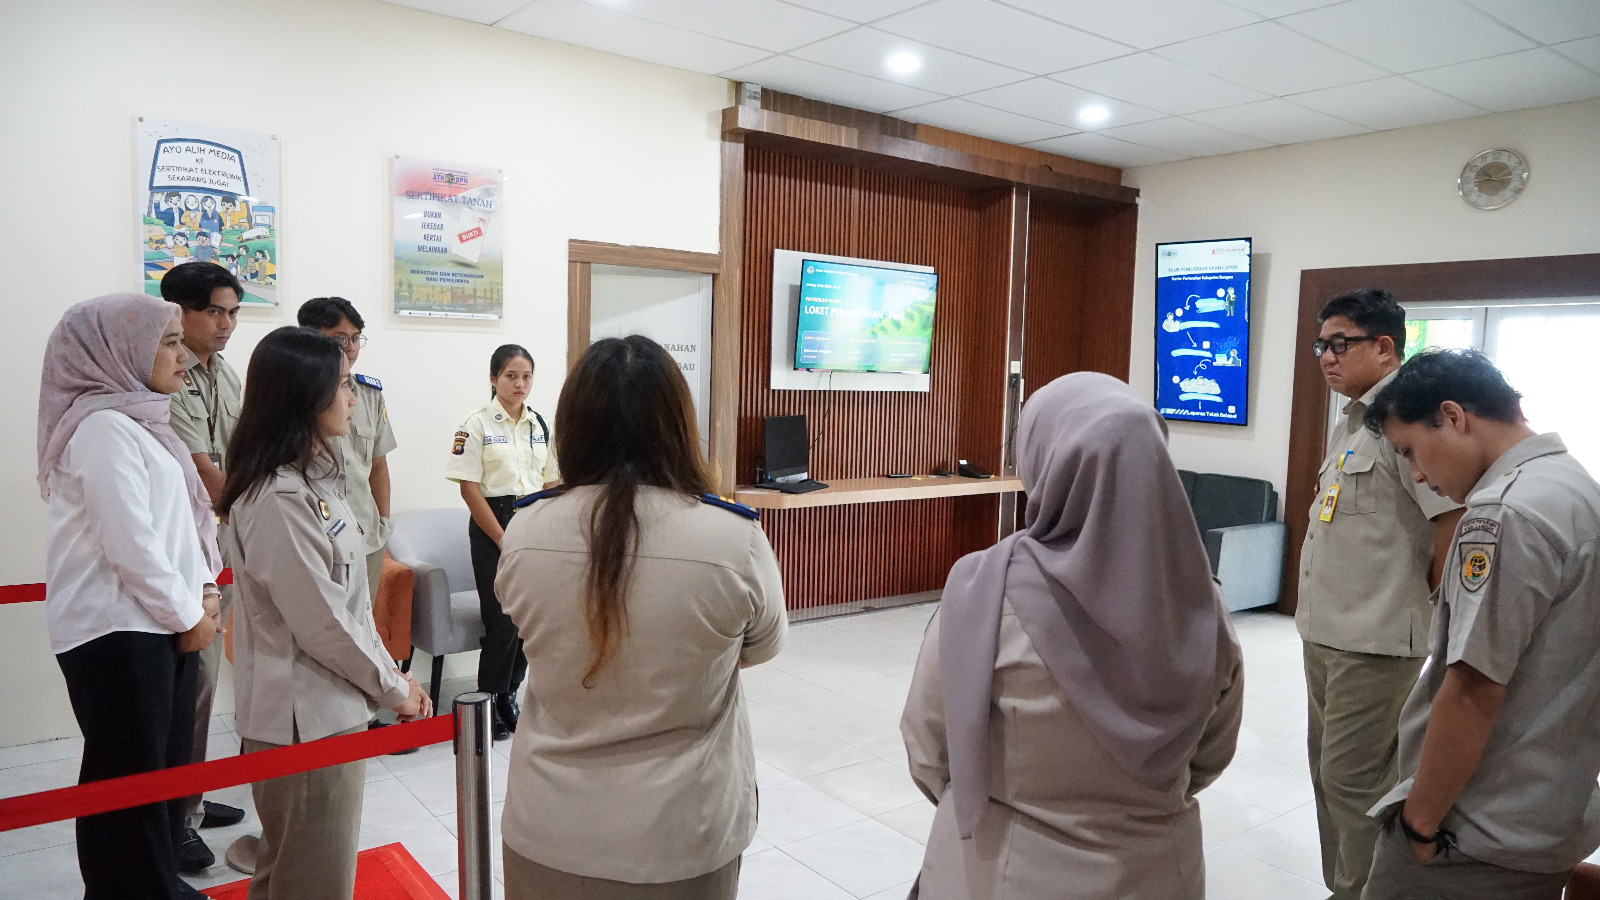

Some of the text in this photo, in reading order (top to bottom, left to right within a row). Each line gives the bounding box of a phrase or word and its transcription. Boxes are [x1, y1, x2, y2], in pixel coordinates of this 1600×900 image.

[163, 146, 236, 163] AYO ALIH MEDIA
[201, 168, 242, 182] ELEKTRONIK
[167, 175, 229, 188] SEKARANG JUGA!
[406, 190, 493, 208] SERTIPIKAT TANAH
[424, 210, 442, 219] BUKAN
[423, 233, 442, 242] KERTAS
[462, 229, 478, 240] BUKTI
[417, 244, 448, 254] MELAINKAN
[804, 306, 829, 315] LOKET
[664, 344, 696, 352] NAHAN
[678, 362, 694, 370] GAU
